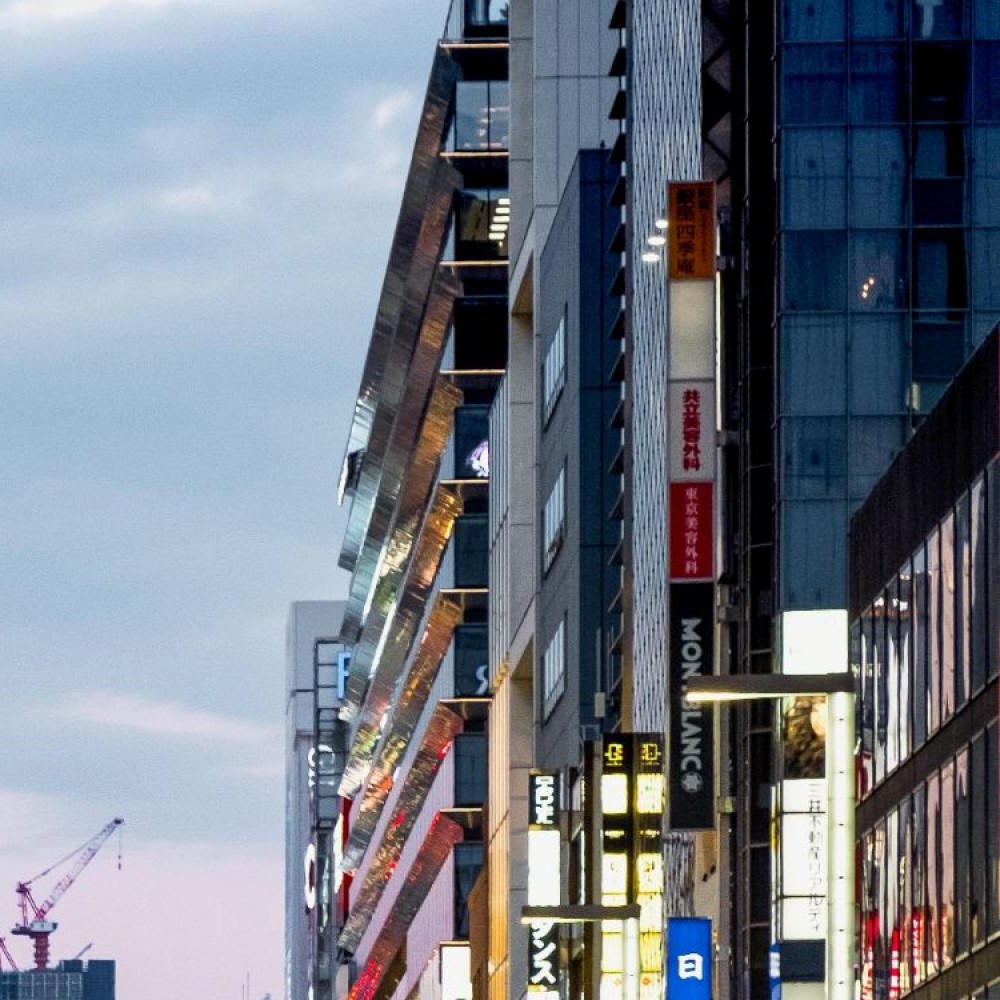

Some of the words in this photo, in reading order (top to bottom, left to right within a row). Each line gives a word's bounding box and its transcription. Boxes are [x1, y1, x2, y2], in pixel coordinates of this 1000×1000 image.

[685, 487, 699, 574] 東京美容外科
[681, 617, 702, 771] MONBLANC
